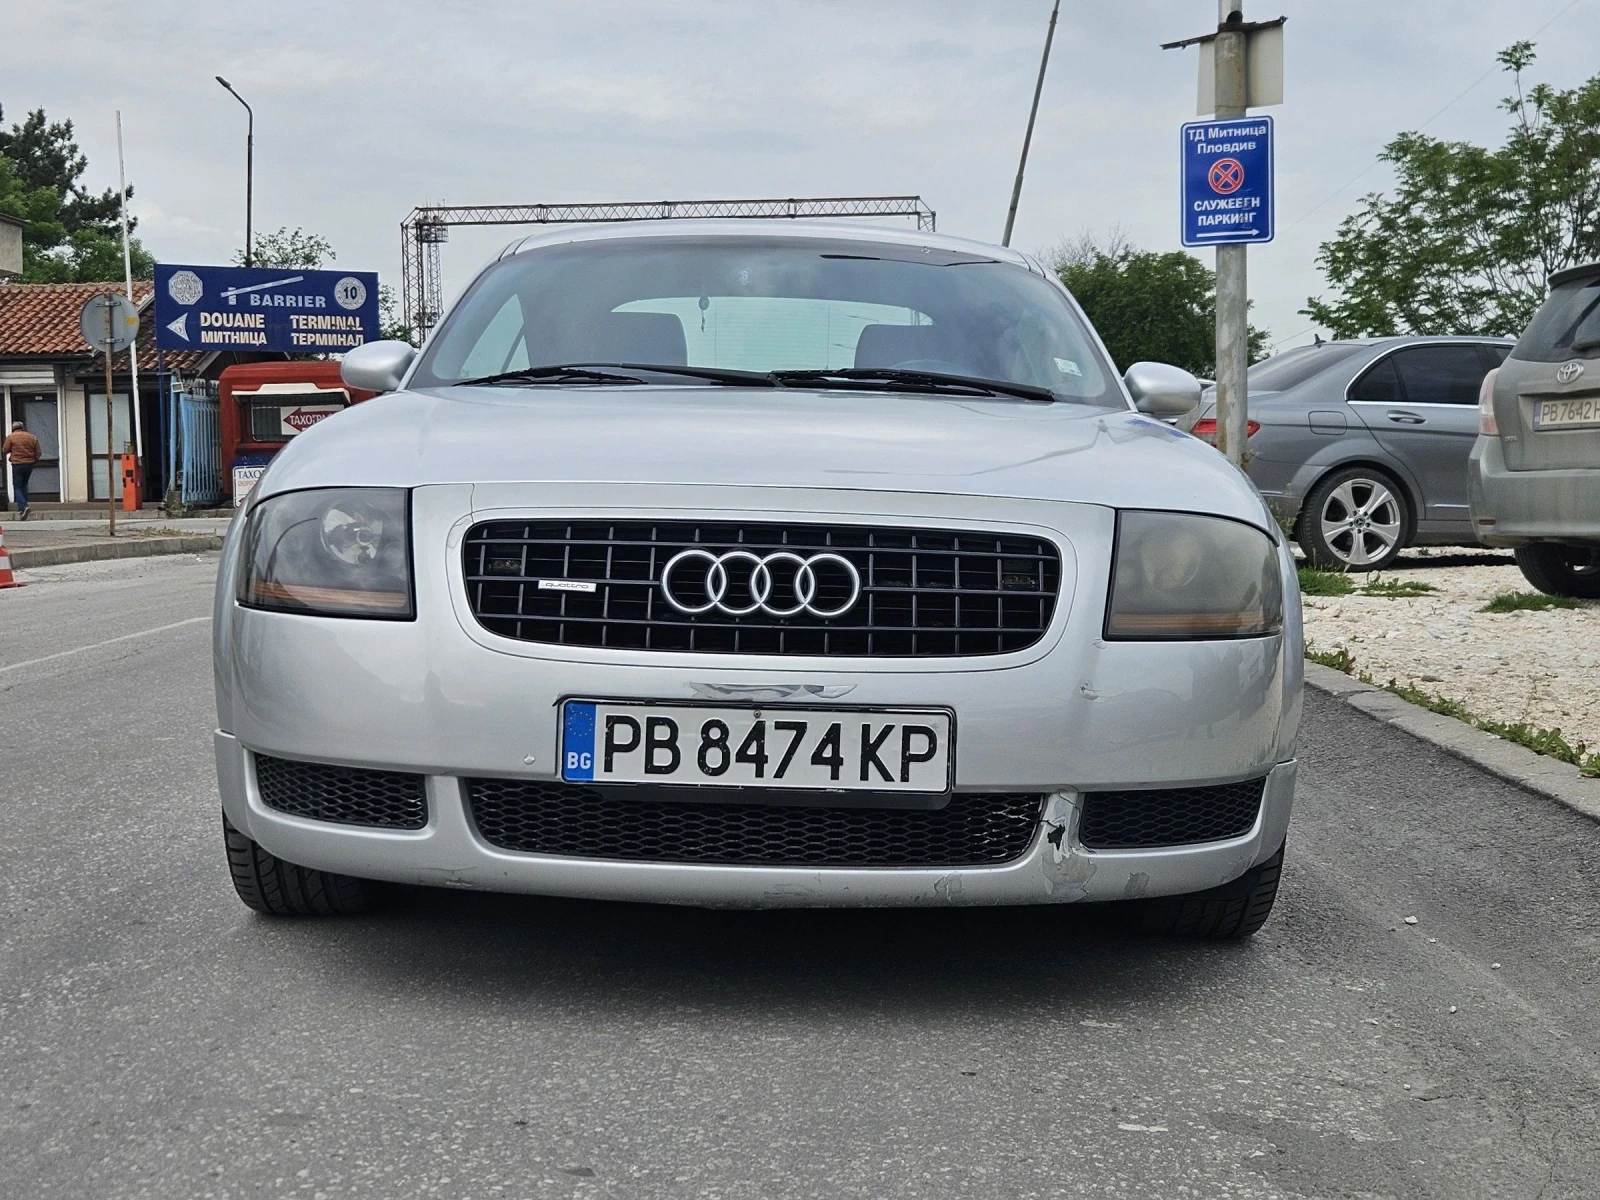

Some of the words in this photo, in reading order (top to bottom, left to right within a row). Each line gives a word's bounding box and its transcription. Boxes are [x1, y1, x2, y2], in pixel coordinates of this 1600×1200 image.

[1187, 129, 1205, 142] ТД
[1208, 126, 1267, 139] Митница
[1197, 142, 1256, 154] Пловдив
[1198, 212, 1257, 226] ПАРКИНГ
[343, 286, 357, 300] 10
[250, 294, 326, 308] BARRIER
[200, 312, 265, 328] DOUANE
[290, 315, 364, 331] TERMINAL
[201, 331, 267, 346] МИТНИЦА
[291, 332, 364, 346] ТЕРМИНАЛ
[1541, 403, 1558, 422] PB
[1560, 399, 1592, 421] 7642
[604, 714, 681, 775] PB
[697, 718, 844, 780] 8474
[860, 723, 938, 783] KP
[567, 752, 592, 770] BG
